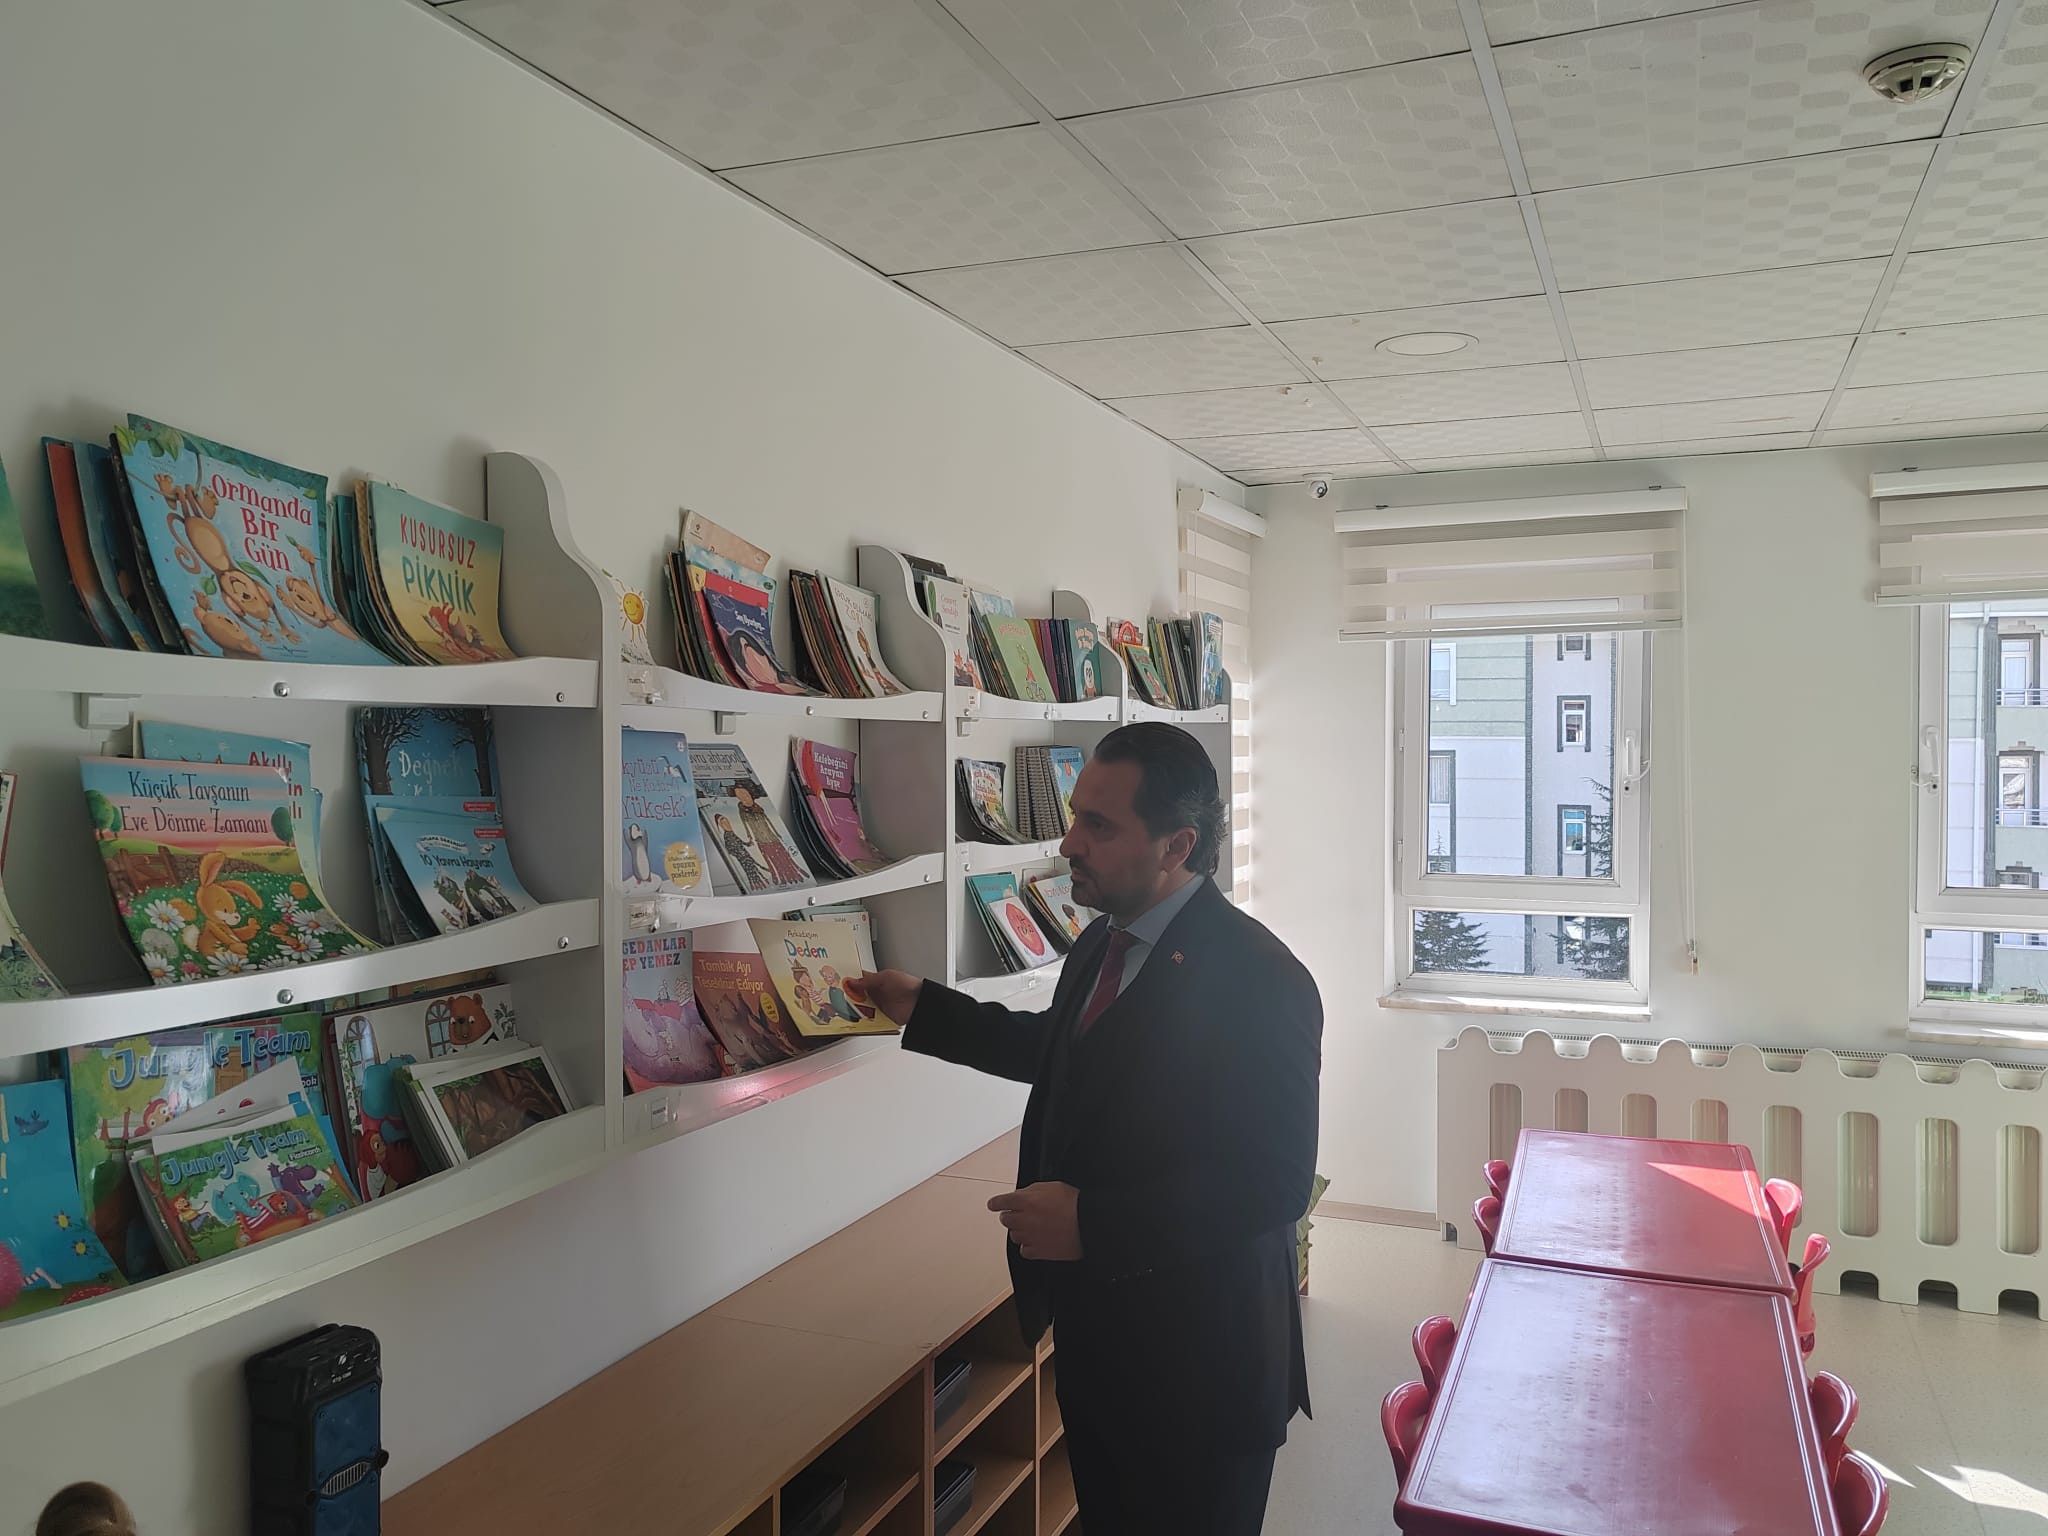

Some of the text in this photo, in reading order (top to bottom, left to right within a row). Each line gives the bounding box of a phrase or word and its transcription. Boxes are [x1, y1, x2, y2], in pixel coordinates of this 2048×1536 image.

[211, 473, 312, 526] Ormanda
[240, 506, 280, 542] Bir
[243, 536, 292, 573] Gün
[400, 512, 476, 569] KUSURSUZ
[402, 554, 477, 617] PİKNİK
[127, 770, 251, 806] Küçük Tavşanın
[820, 765, 845, 779] Arayan
[119, 805, 269, 834] Eve Dönme Zamanı
[418, 854, 494, 870] 10 Yavru Hayvan
[622, 936, 687, 955] GEDANLAR
[639, 952, 681, 970] YEMEZ
[783, 938, 829, 959] Dedem
[698, 959, 752, 977] Tombik Ayı
[735, 977, 765, 994] Ediyor
[234, 1029, 312, 1068] Team
[160, 1127, 312, 1187] Jungle Team
